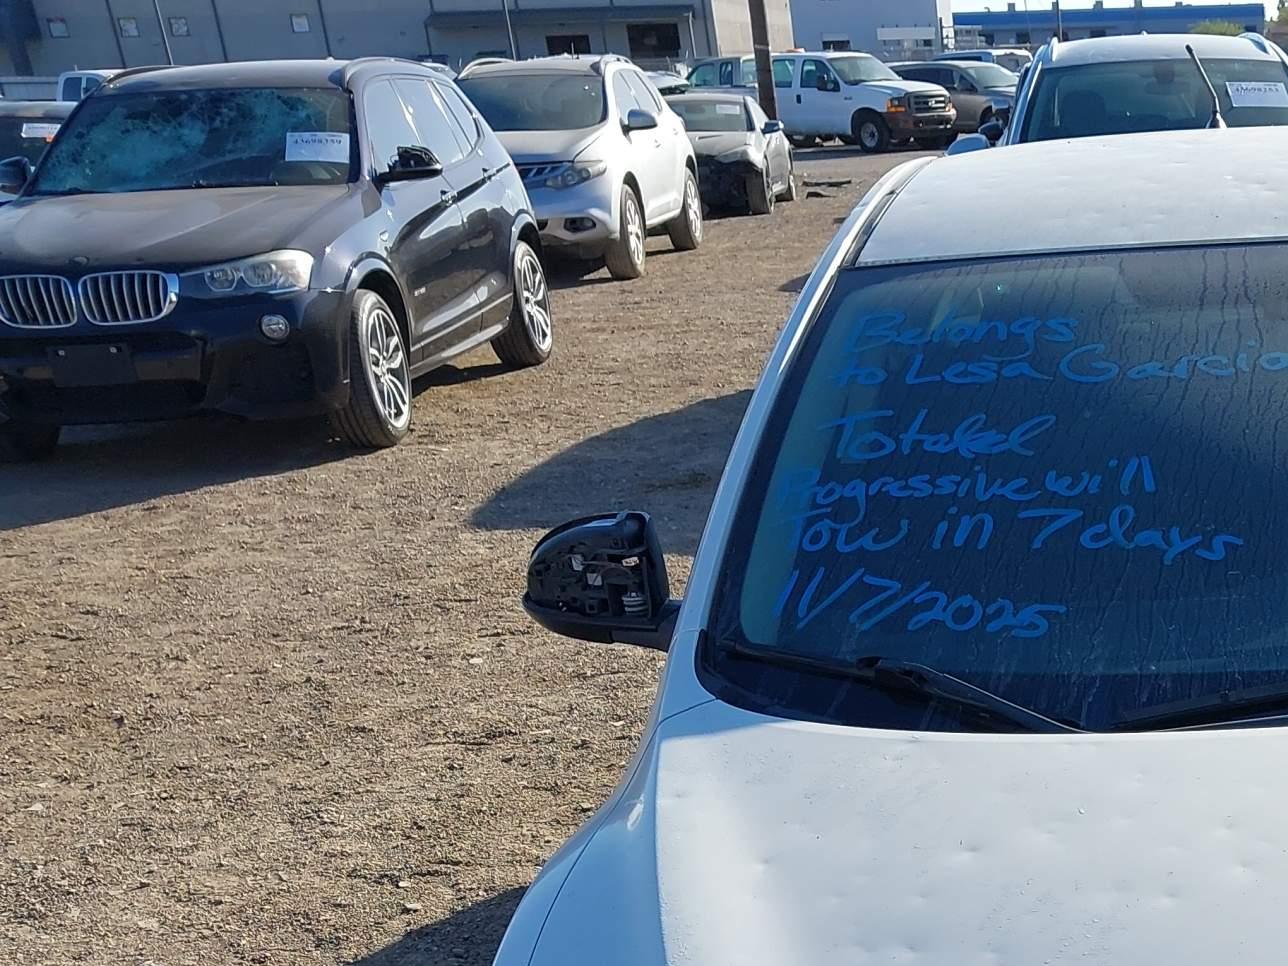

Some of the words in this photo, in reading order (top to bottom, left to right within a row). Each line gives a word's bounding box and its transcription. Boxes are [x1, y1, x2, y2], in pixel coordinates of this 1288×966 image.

[852, 310, 1079, 361] Belongs
[833, 355, 888, 386] to
[1045, 455, 1157, 497] will
[787, 507, 909, 553] Tow
[931, 506, 994, 550] in
[1017, 507, 1083, 549] 7
[1079, 504, 1244, 566] days
[773, 566, 1068, 638] 11/7/2025
